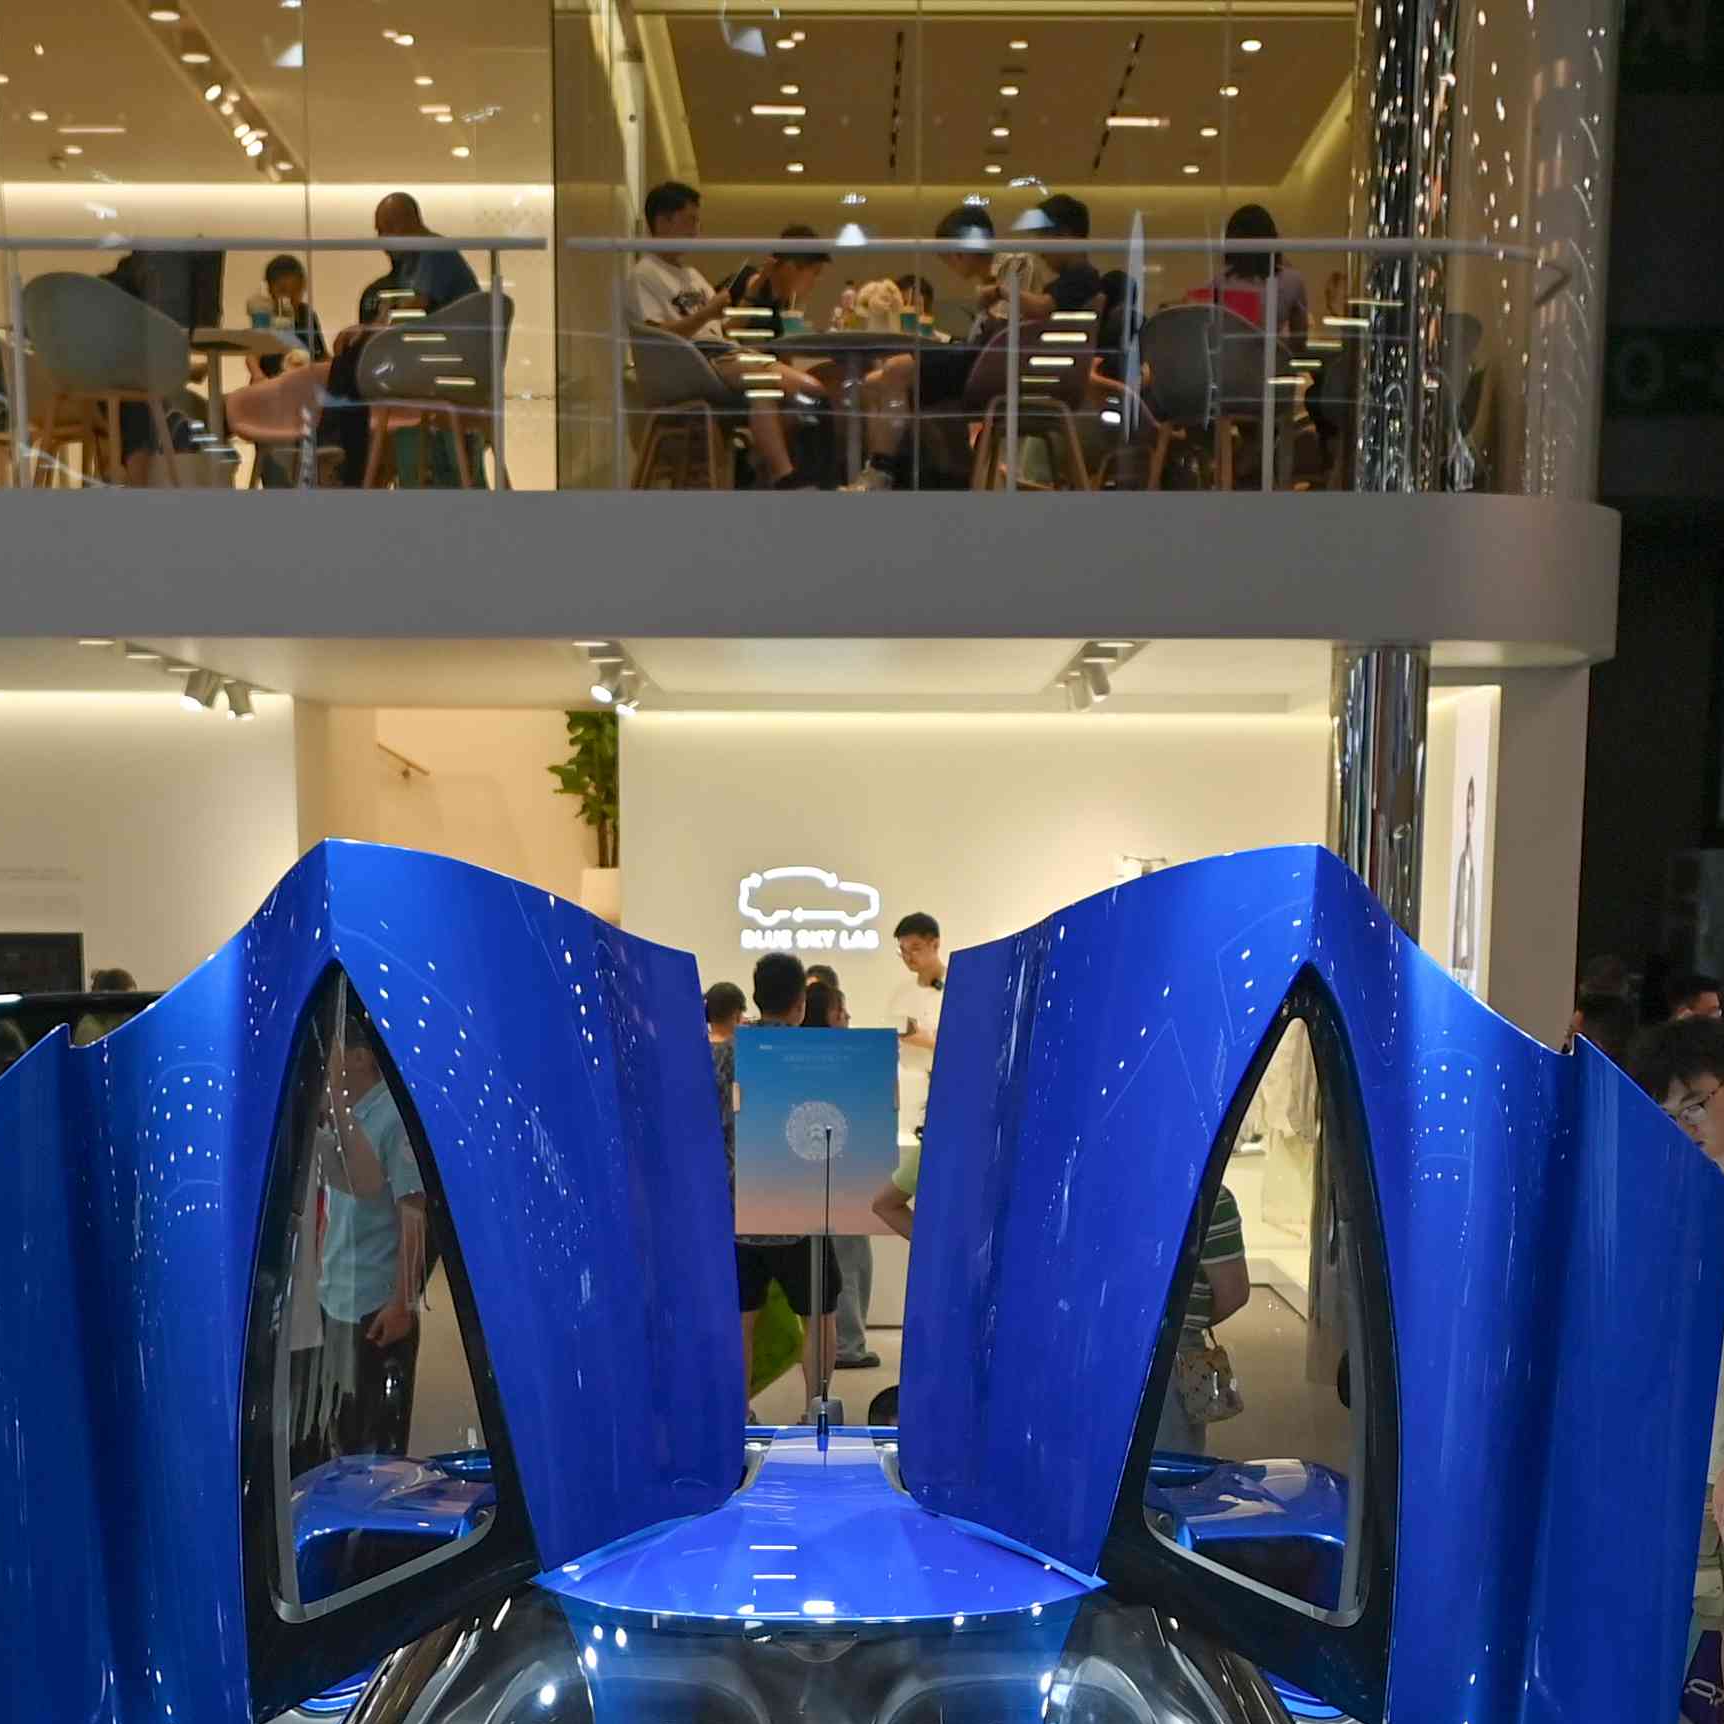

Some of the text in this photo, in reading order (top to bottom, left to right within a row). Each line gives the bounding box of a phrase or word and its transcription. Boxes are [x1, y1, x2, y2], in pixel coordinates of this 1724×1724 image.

[740, 929, 879, 949] BLUE SKY LAB
